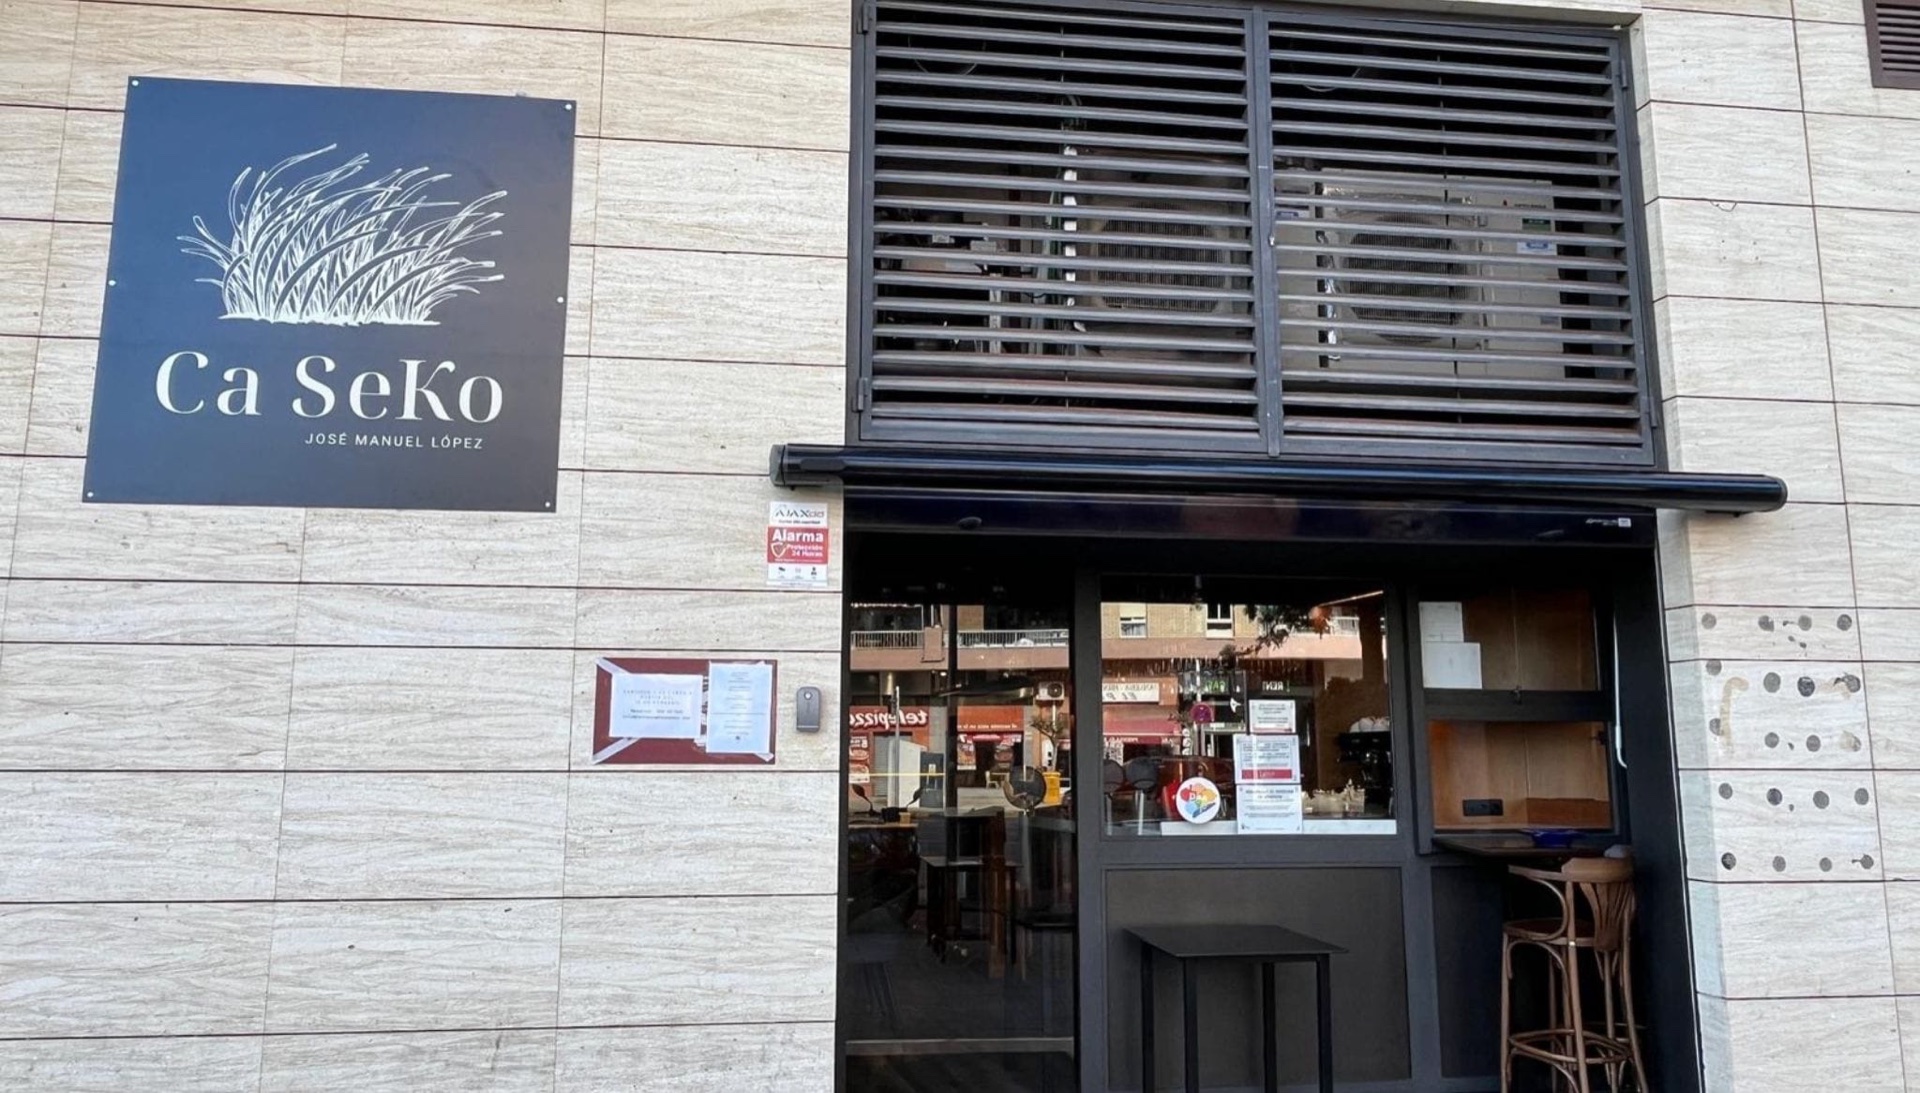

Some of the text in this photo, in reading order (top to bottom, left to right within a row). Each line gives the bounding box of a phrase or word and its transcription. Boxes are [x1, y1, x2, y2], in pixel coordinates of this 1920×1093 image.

[155, 350, 504, 424] Ca SeKo
[304, 430, 485, 450] JOSÉ MANUEL LÓPEZ
[772, 528, 824, 542] Alarma
